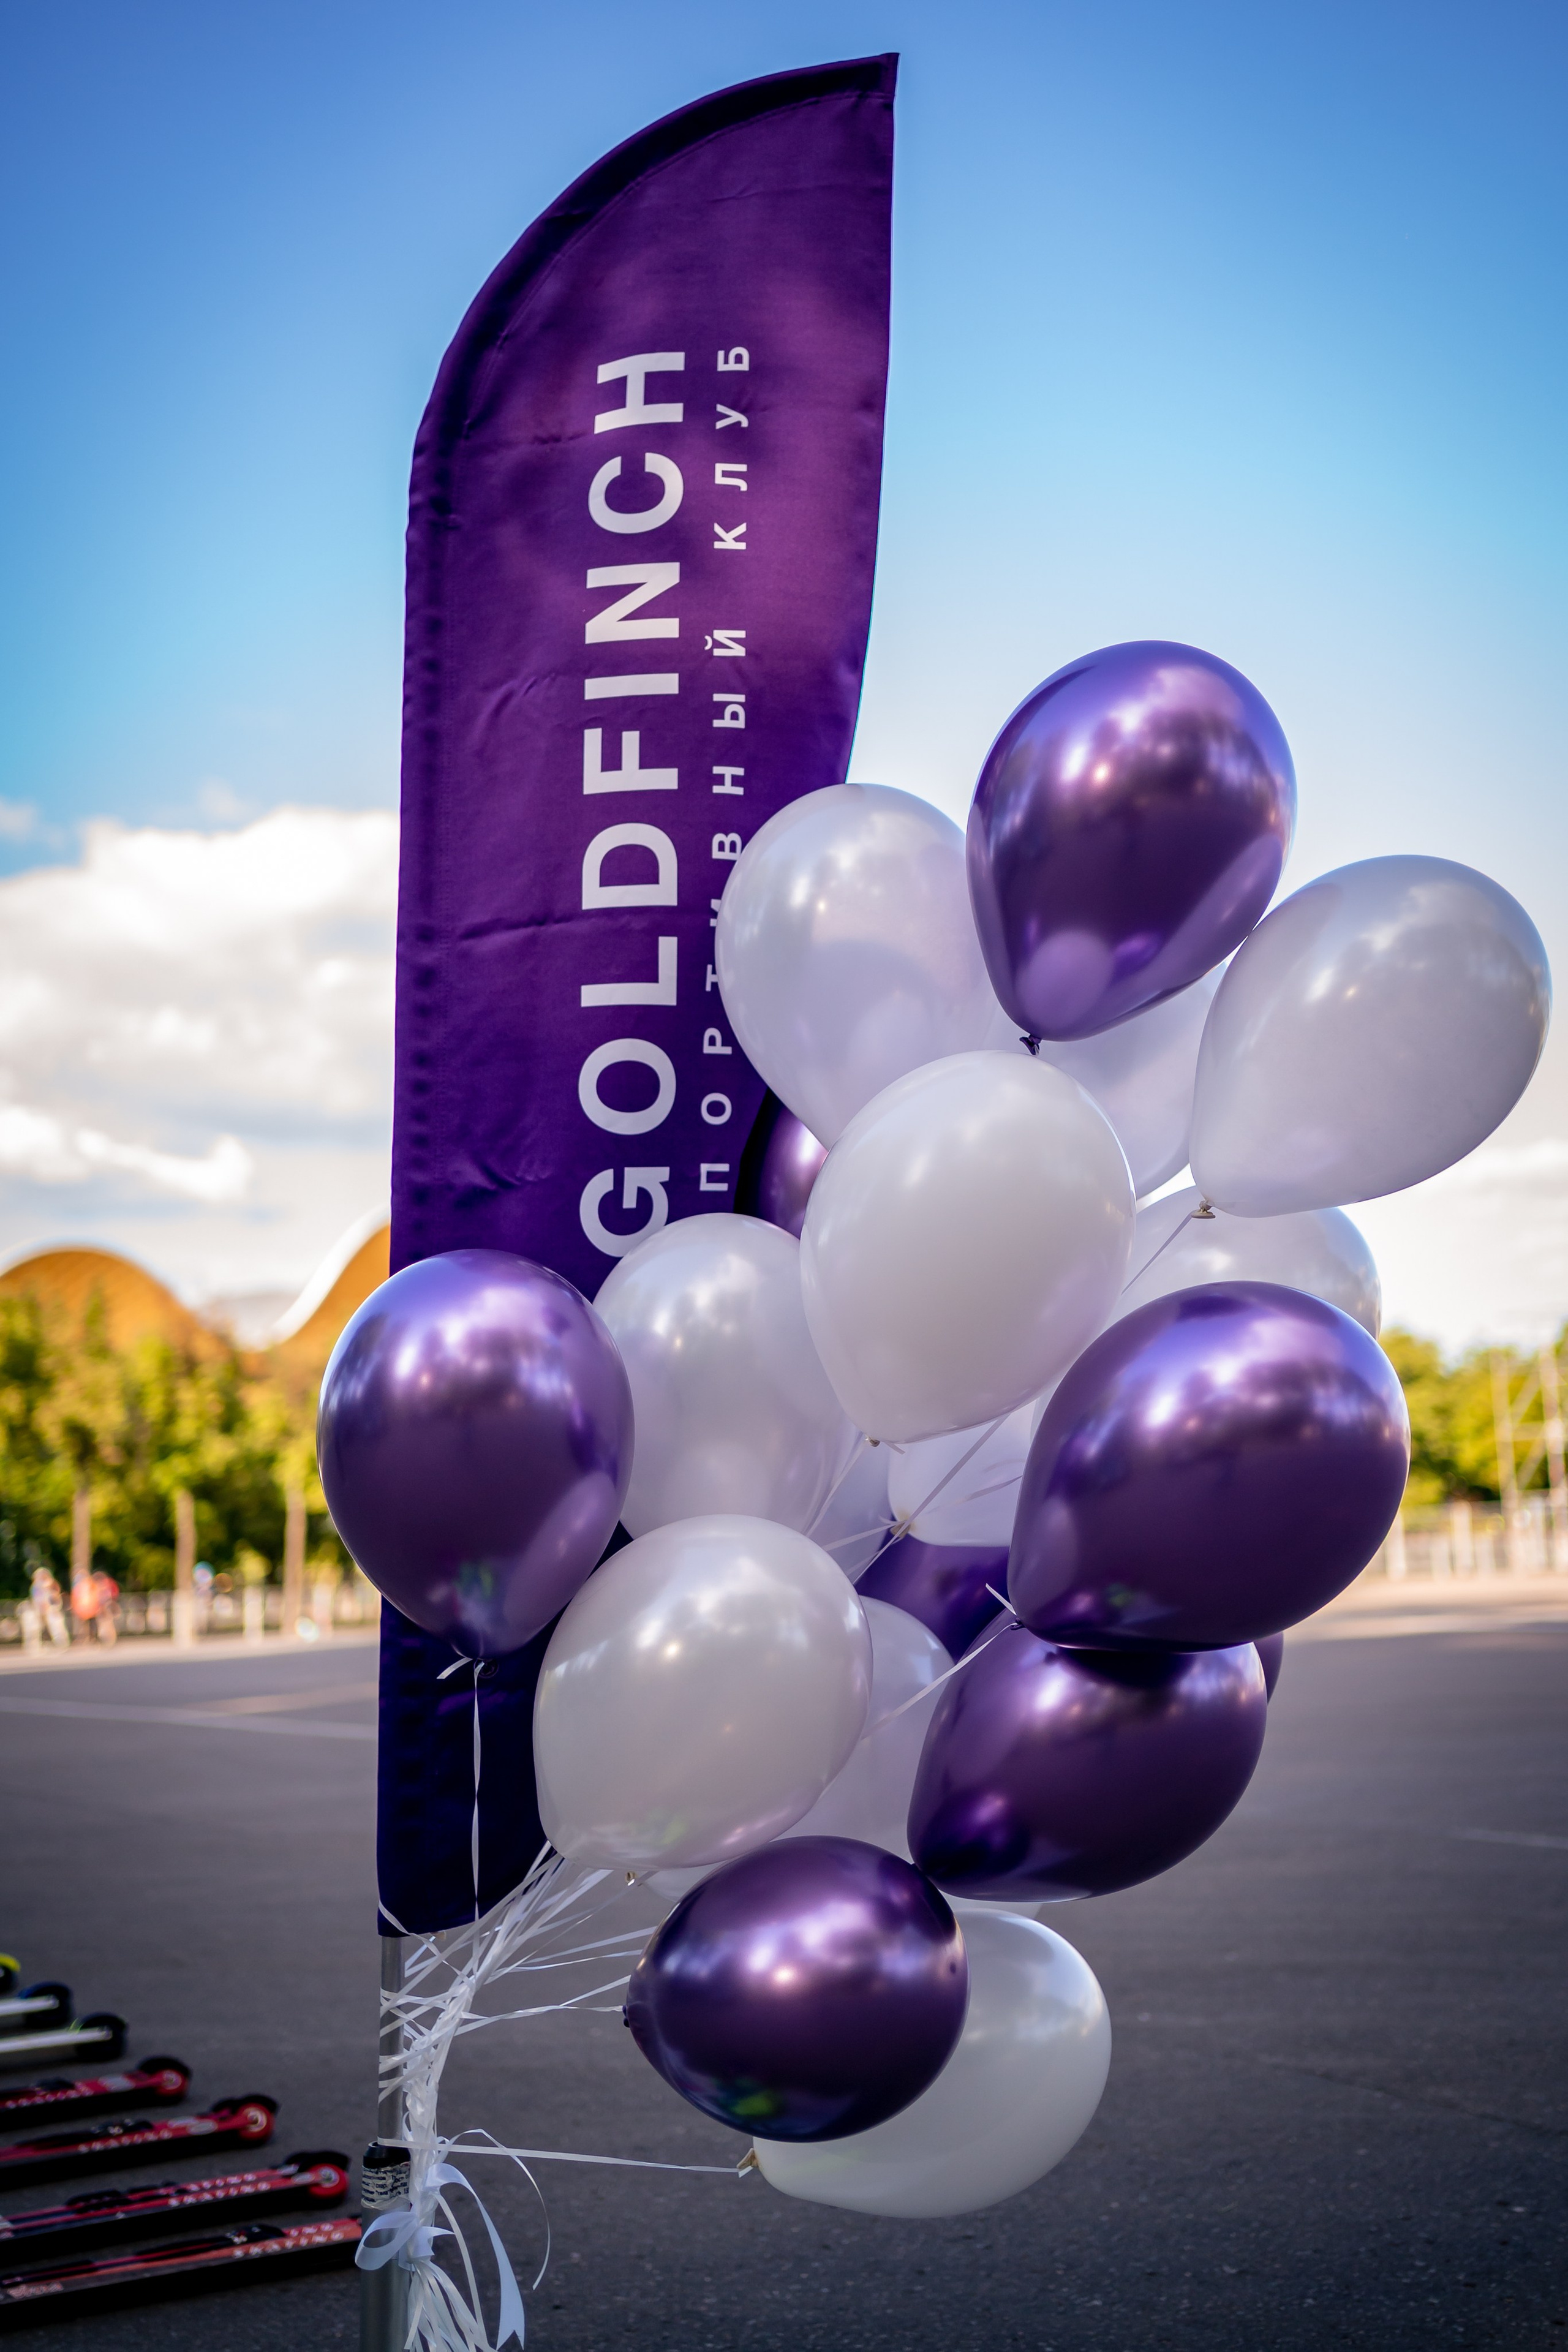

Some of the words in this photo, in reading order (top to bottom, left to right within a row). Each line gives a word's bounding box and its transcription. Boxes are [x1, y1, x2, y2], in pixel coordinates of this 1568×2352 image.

[713, 347, 750, 550] КЛУБ
[578, 351, 685, 1257] GOLDFINCH
[699, 629, 746, 1191] ПОРТВНЫЙ
